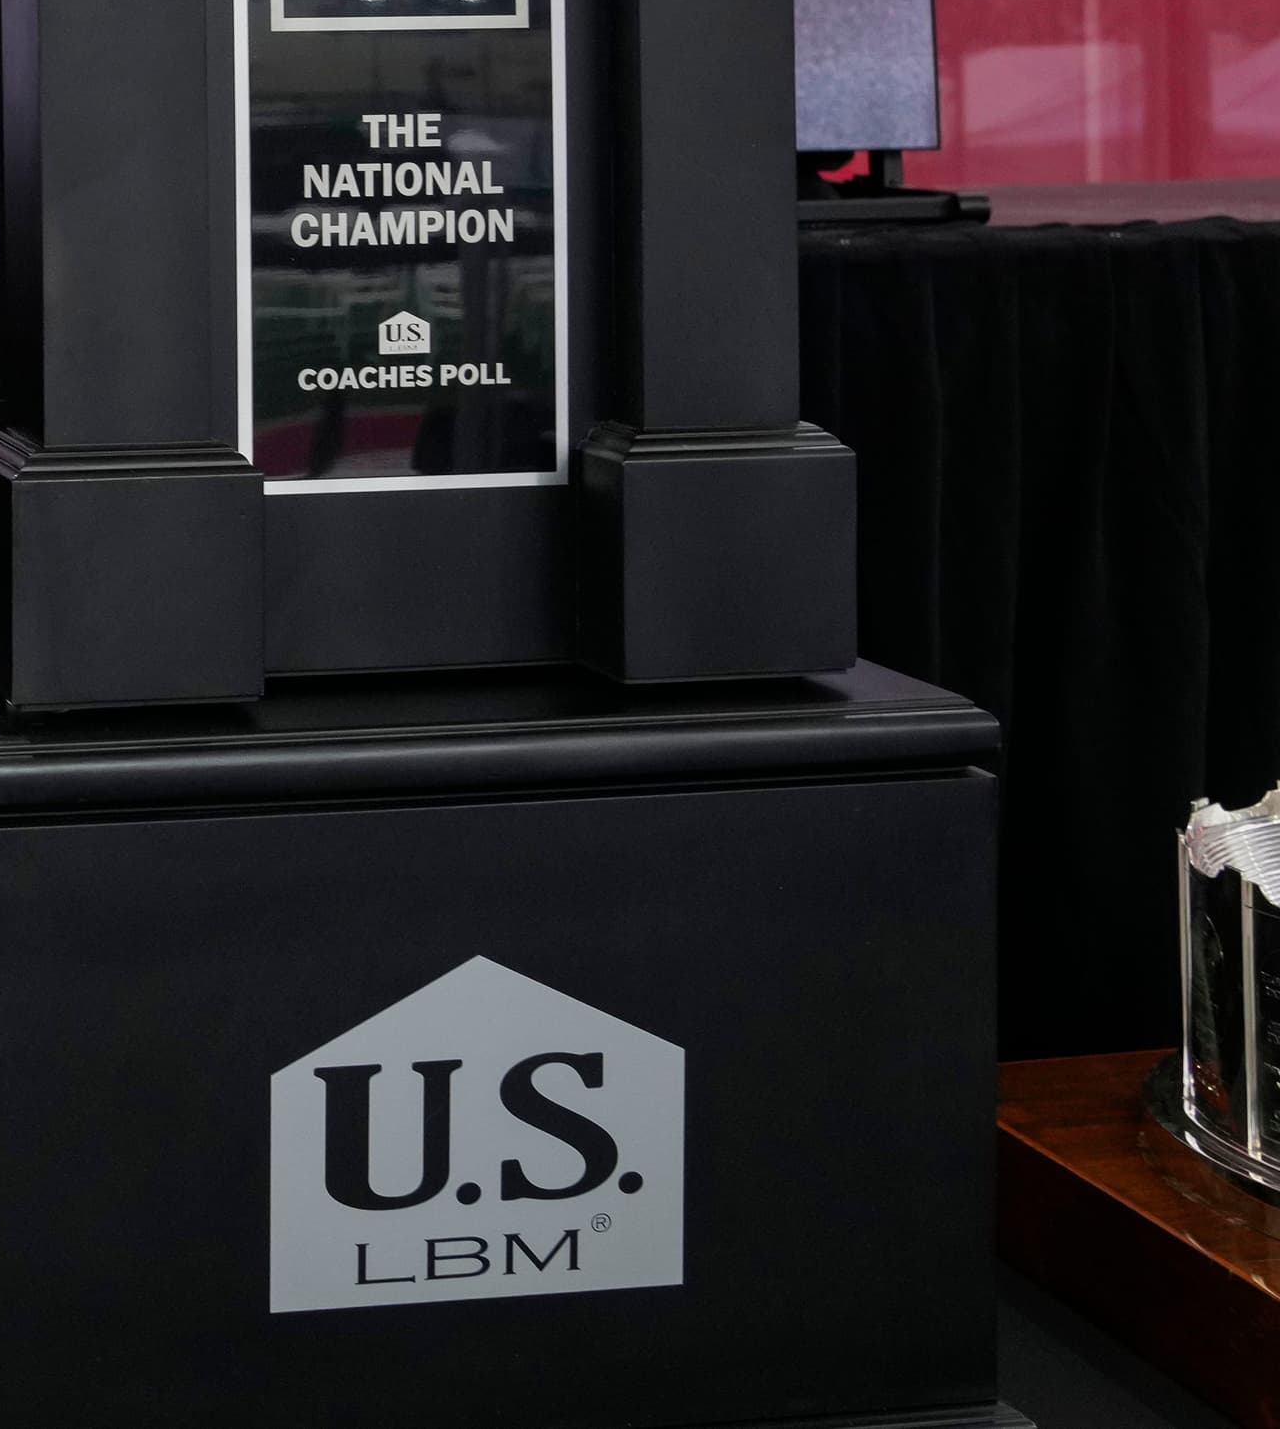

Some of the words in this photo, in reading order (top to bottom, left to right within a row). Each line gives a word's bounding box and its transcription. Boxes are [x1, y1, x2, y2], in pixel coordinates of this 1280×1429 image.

[362, 113, 442, 148] THE
[303, 161, 504, 198] NATIONAL
[291, 208, 514, 247] CHAMPION
[385, 323, 425, 342] U.S.
[298, 365, 433, 391] COACHES
[440, 362, 511, 386] POLL
[313, 1052, 644, 1211] U.S.
